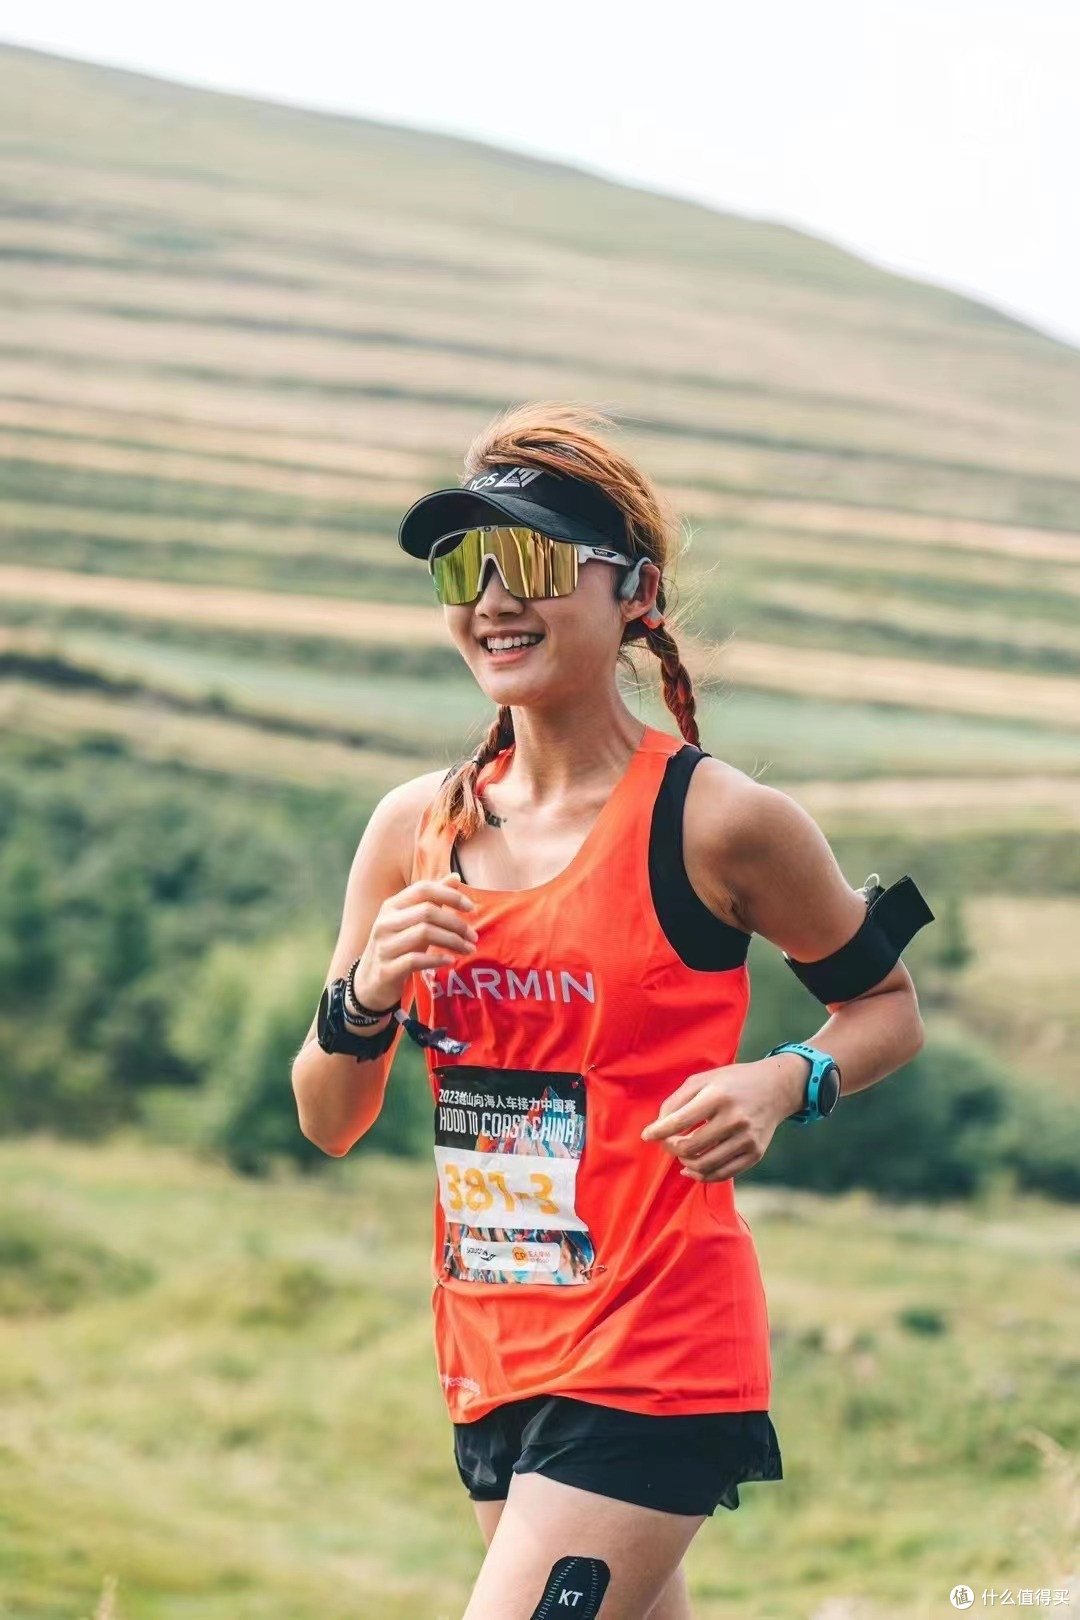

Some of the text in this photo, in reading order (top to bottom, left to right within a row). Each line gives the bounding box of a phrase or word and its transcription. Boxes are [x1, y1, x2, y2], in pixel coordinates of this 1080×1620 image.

[439, 1107, 576, 1143] HOOD TO COAST CHINA
[558, 1589, 583, 1607] KT
